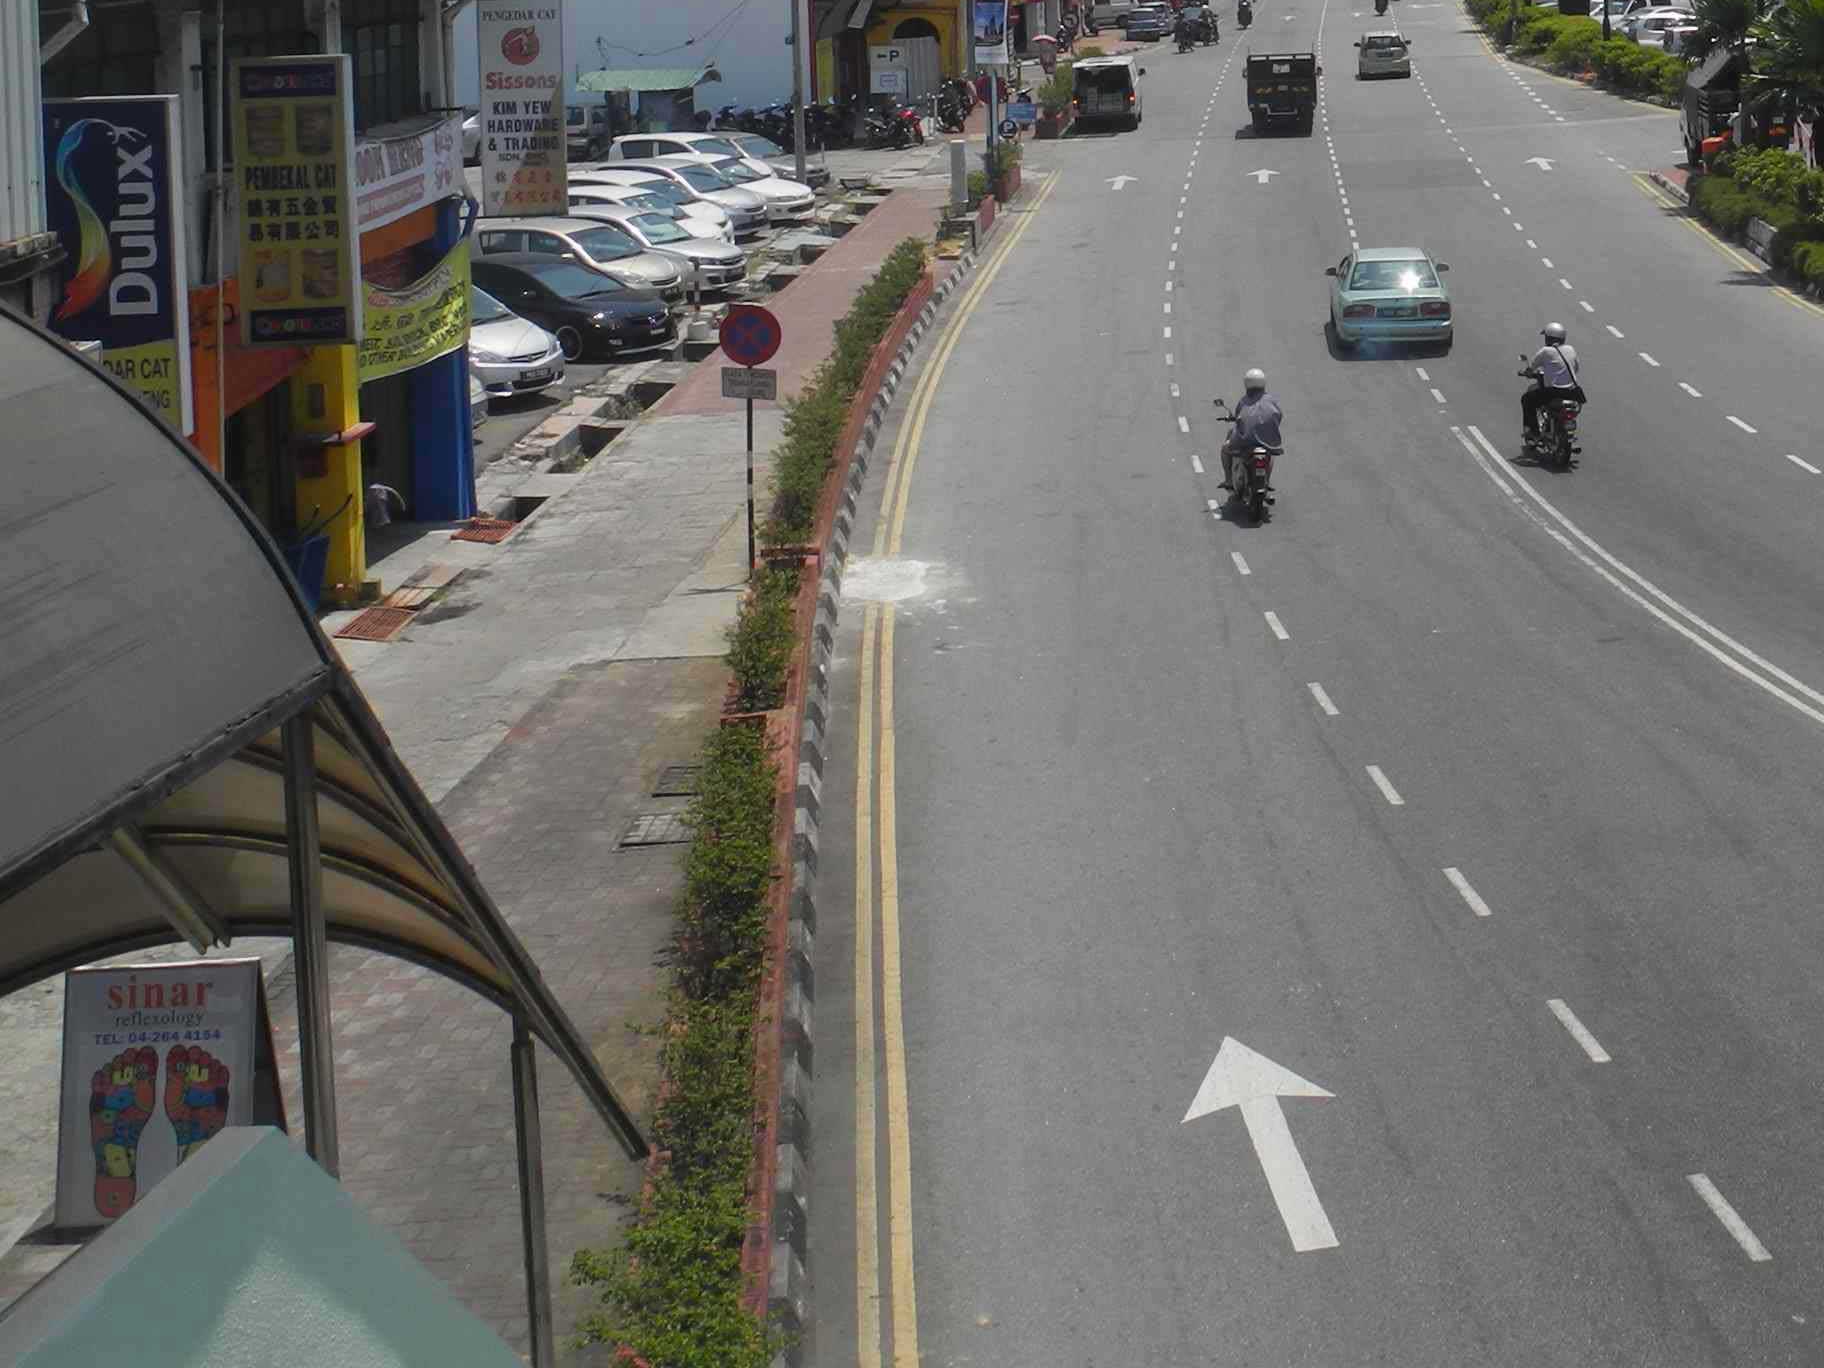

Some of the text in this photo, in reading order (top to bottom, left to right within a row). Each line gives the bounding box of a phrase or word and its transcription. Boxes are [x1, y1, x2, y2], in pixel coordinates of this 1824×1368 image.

[486, 72, 557, 89] Sissons
[493, 100, 552, 114] KIM YEW
[488, 118, 561, 132] HARDWARE
[488, 137, 497, 151] &
[109, 145, 158, 316] Dulux
[140, 358, 171, 379] CAT
[107, 974, 214, 1010] sinar
[114, 1010, 205, 1028] reflexology
